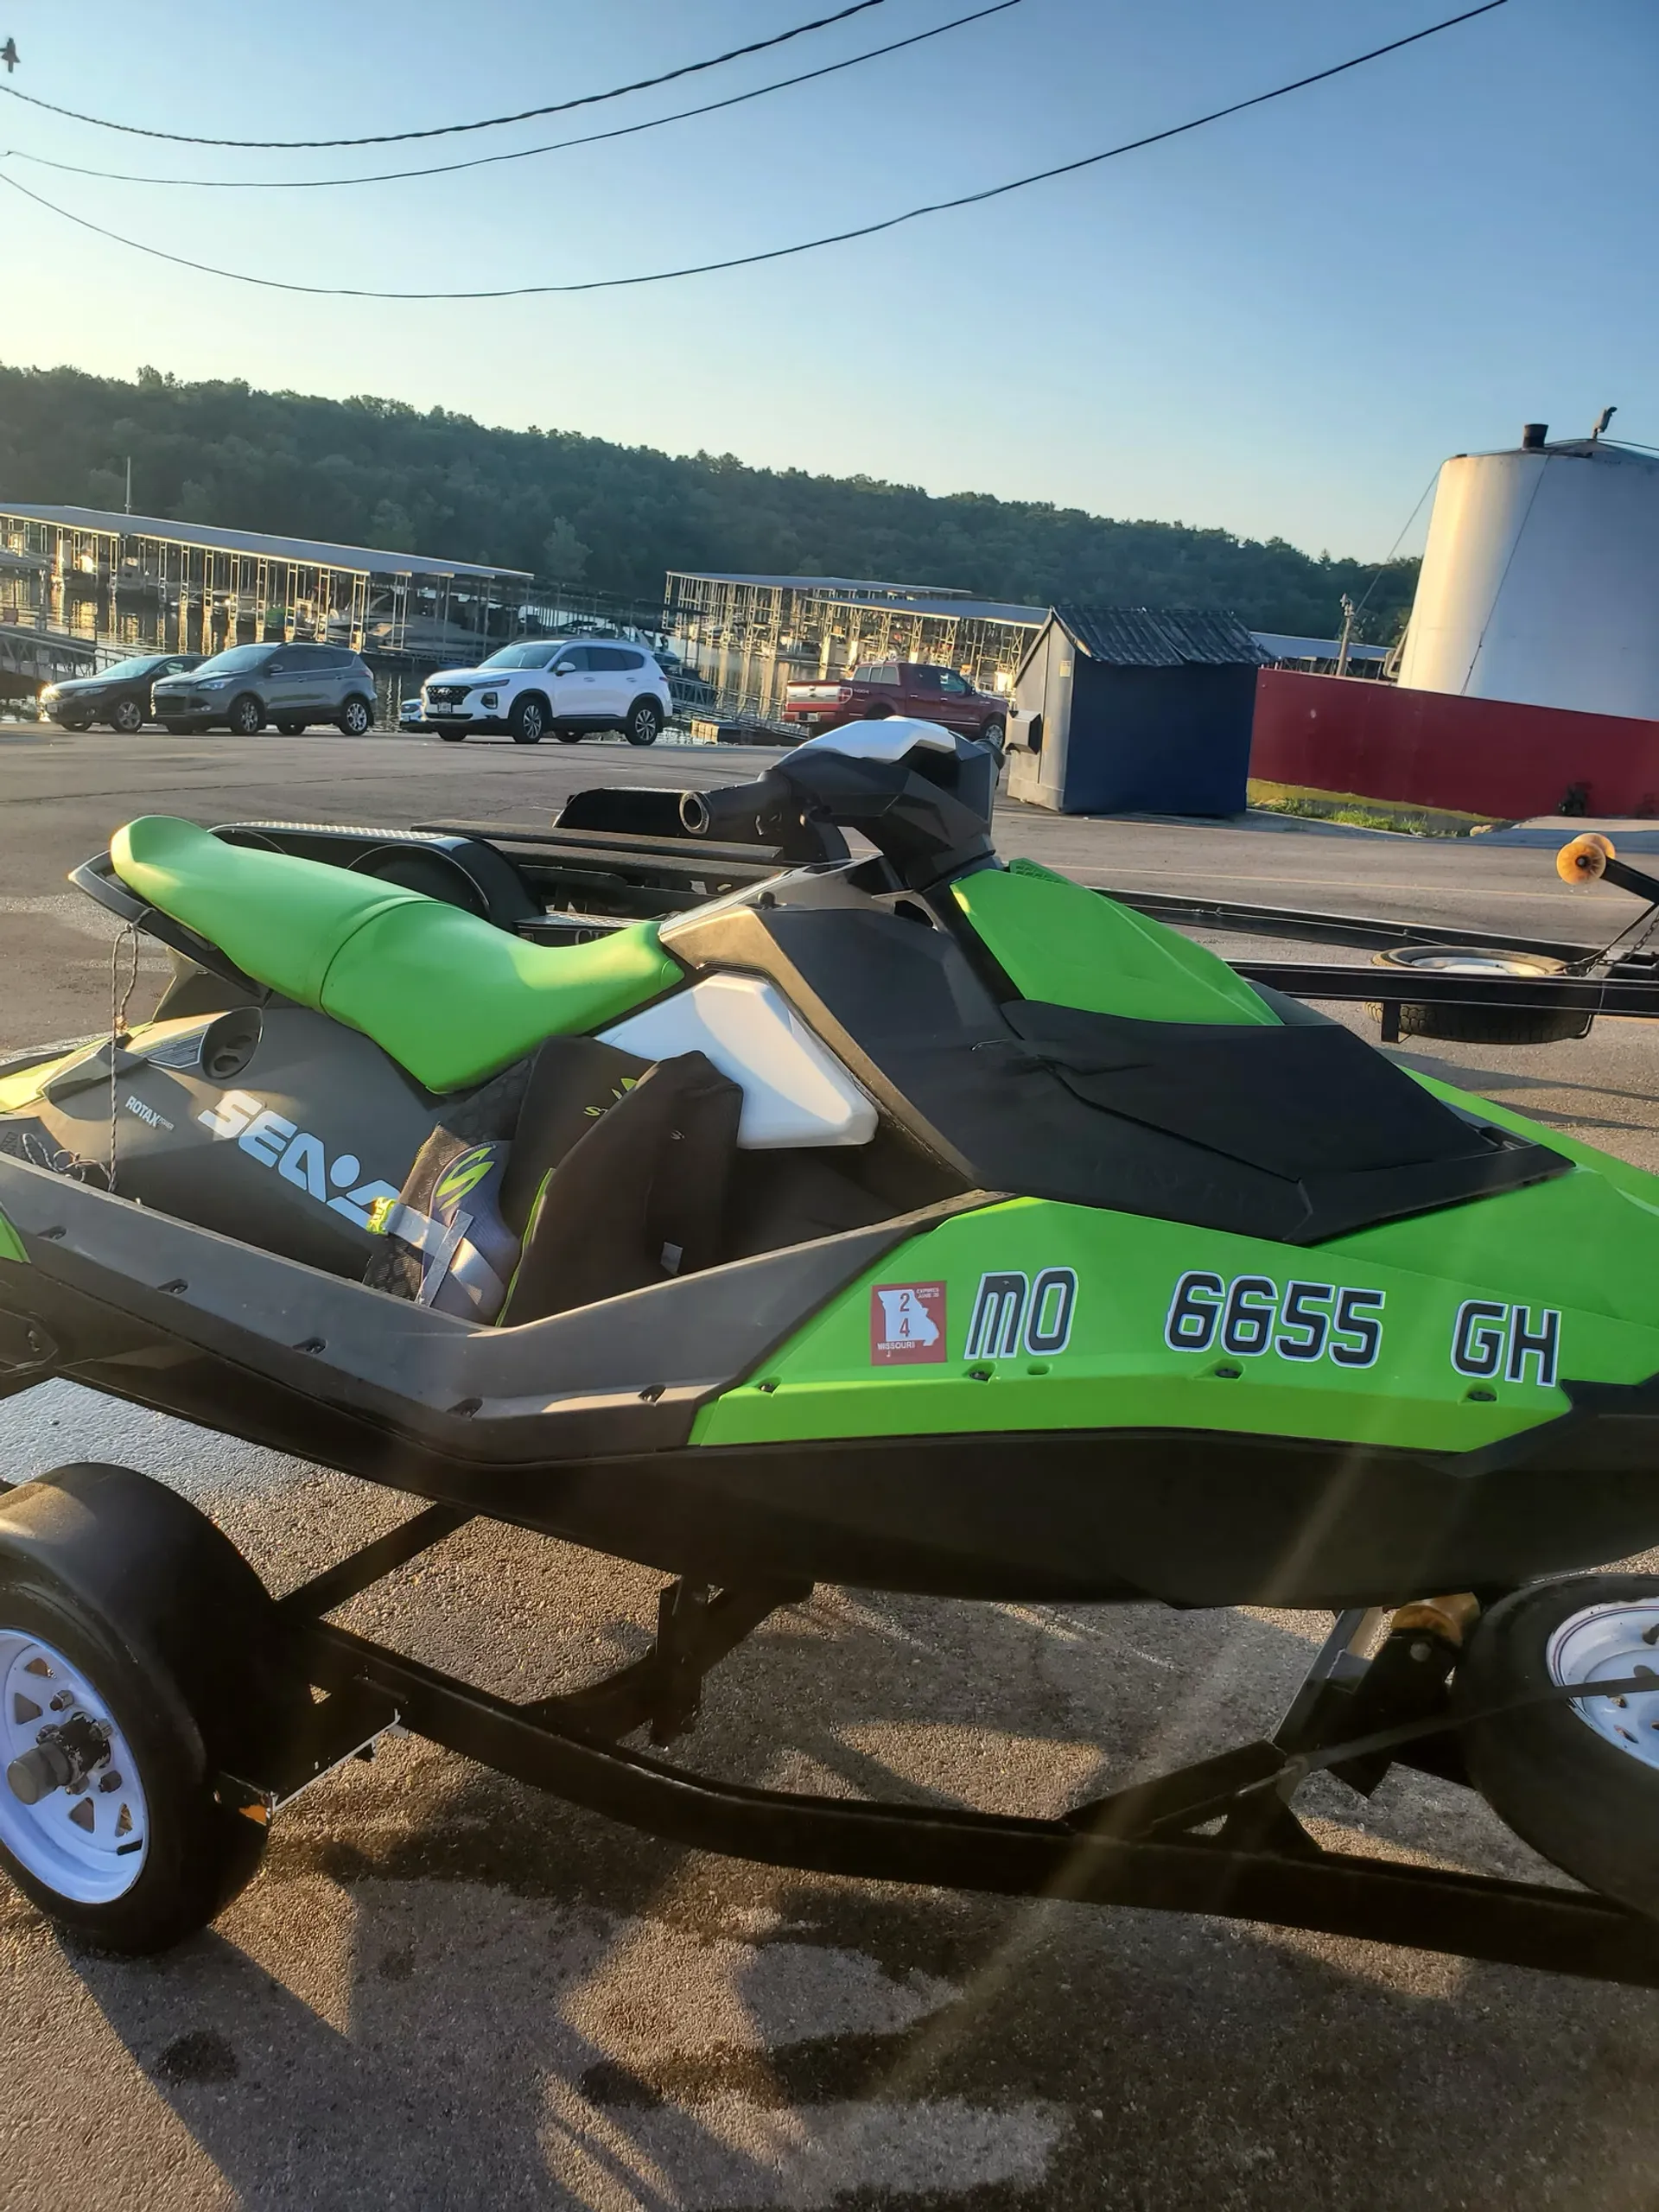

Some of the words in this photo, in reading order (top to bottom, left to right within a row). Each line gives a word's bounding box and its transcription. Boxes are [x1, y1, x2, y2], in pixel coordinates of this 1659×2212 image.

[125, 1095, 161, 1127] ROTAX
[899, 1292, 910, 1312] 2
[899, 1318, 910, 1338] 4
[963, 1267, 1079, 1360] MO
[1165, 1270, 1386, 1369] 6655
[1451, 1299, 1561, 1388] GH
[877, 1341, 916, 1351] MISSOURI
